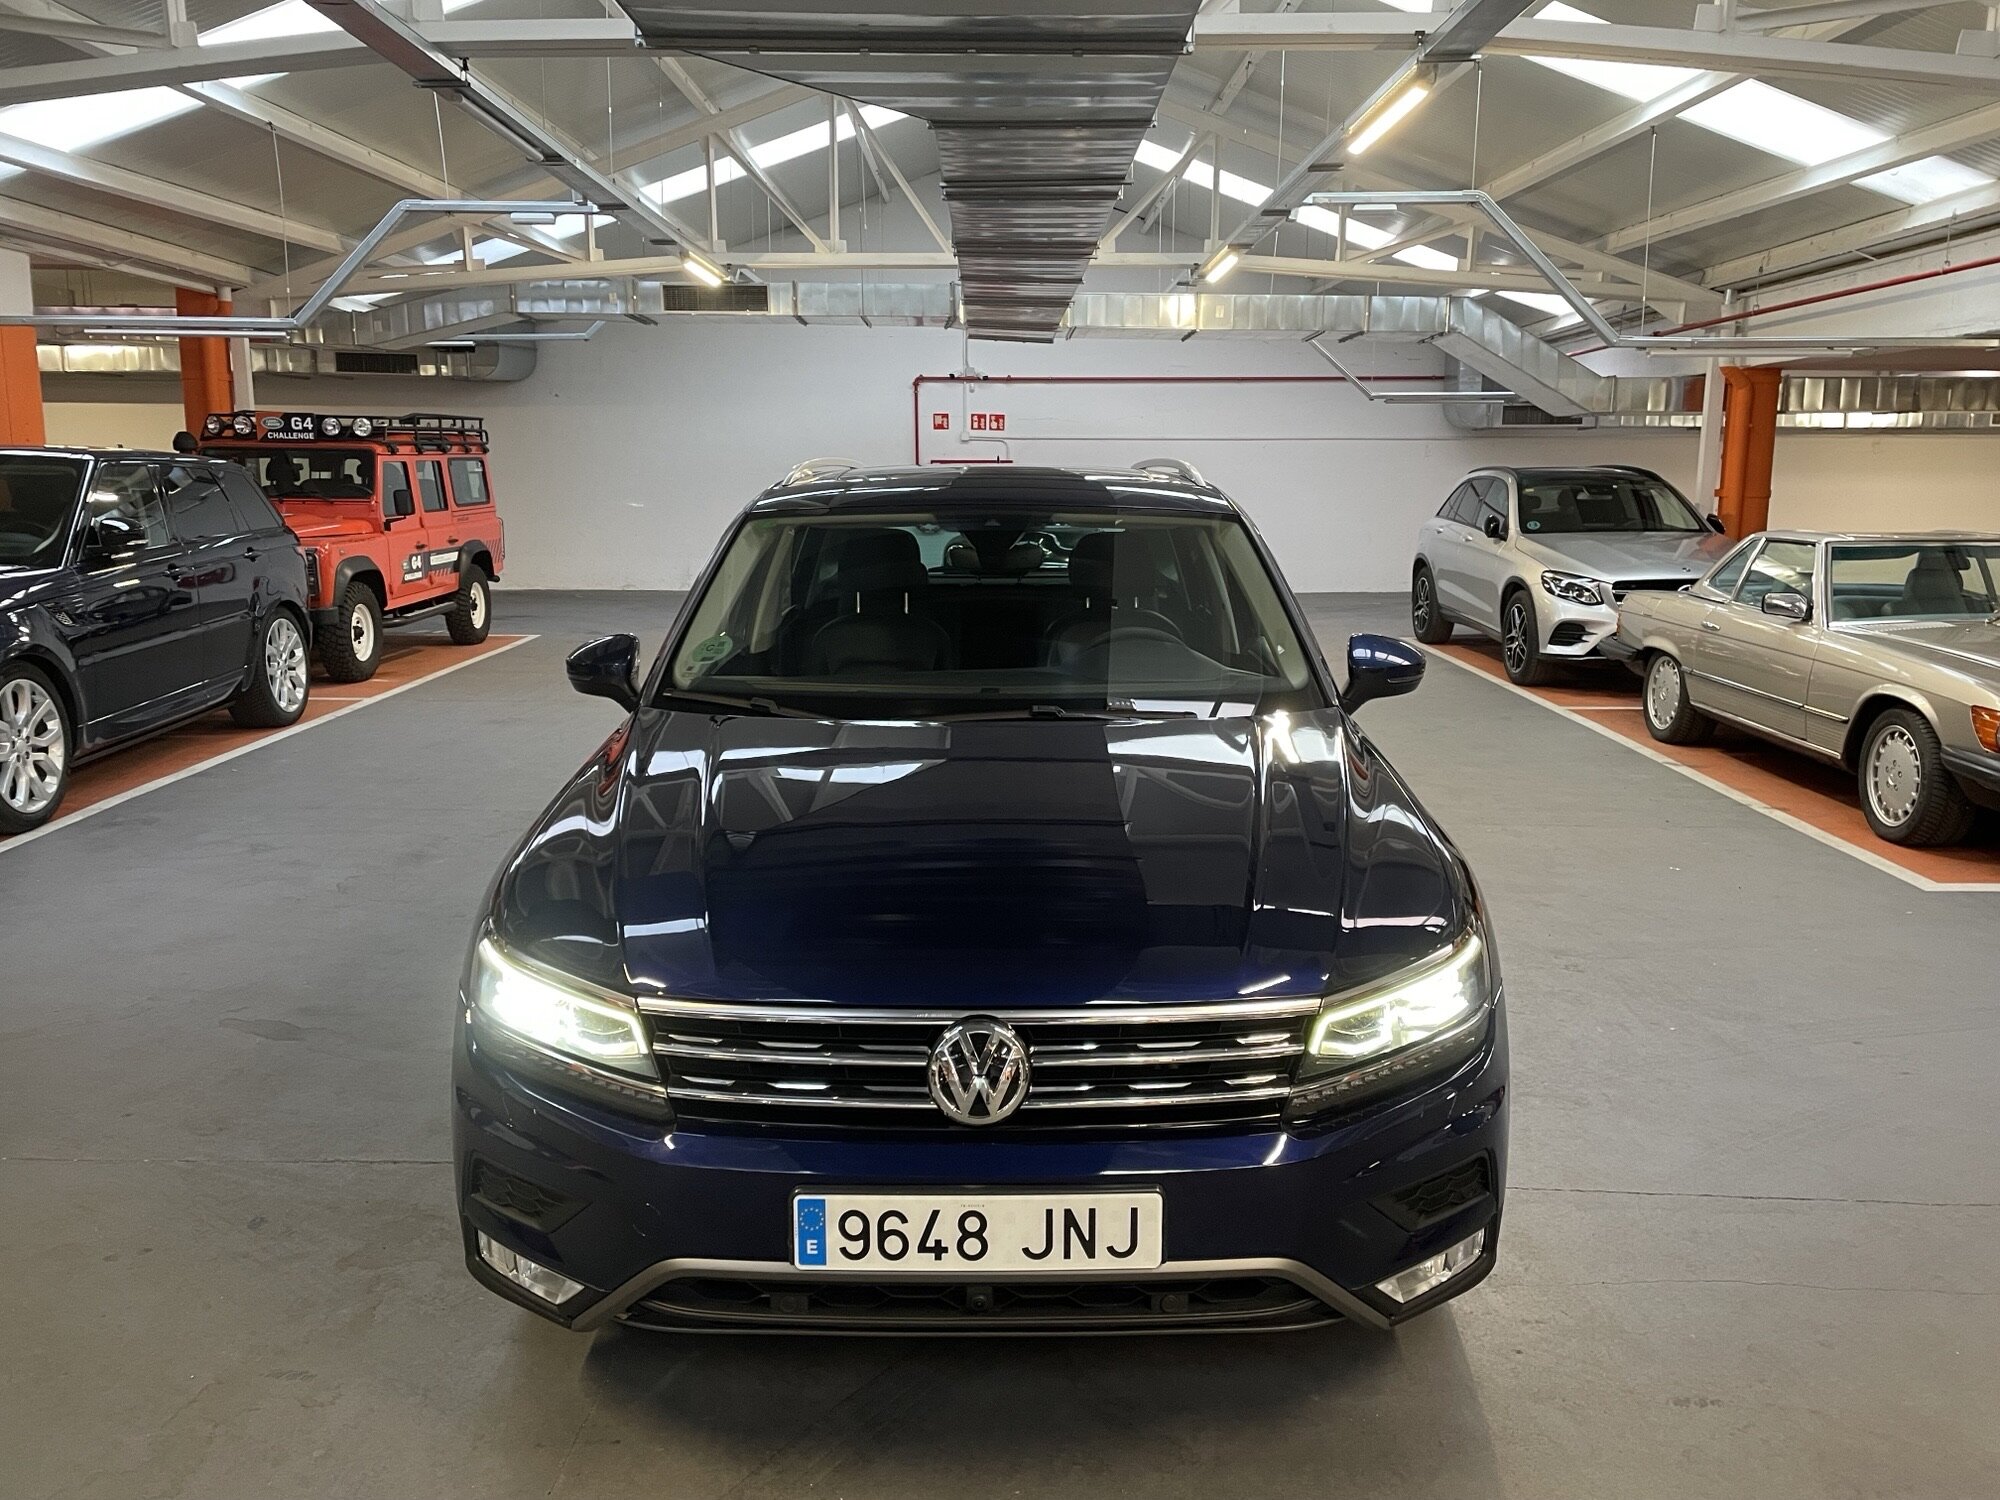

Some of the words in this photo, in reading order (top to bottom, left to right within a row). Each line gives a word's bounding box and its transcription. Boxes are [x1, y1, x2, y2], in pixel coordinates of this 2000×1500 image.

[291, 417, 313, 430] G4
[838, 1209, 989, 1261] 9648
[1021, 1207, 1139, 1260] JNJ
[807, 1240, 818, 1254] E
